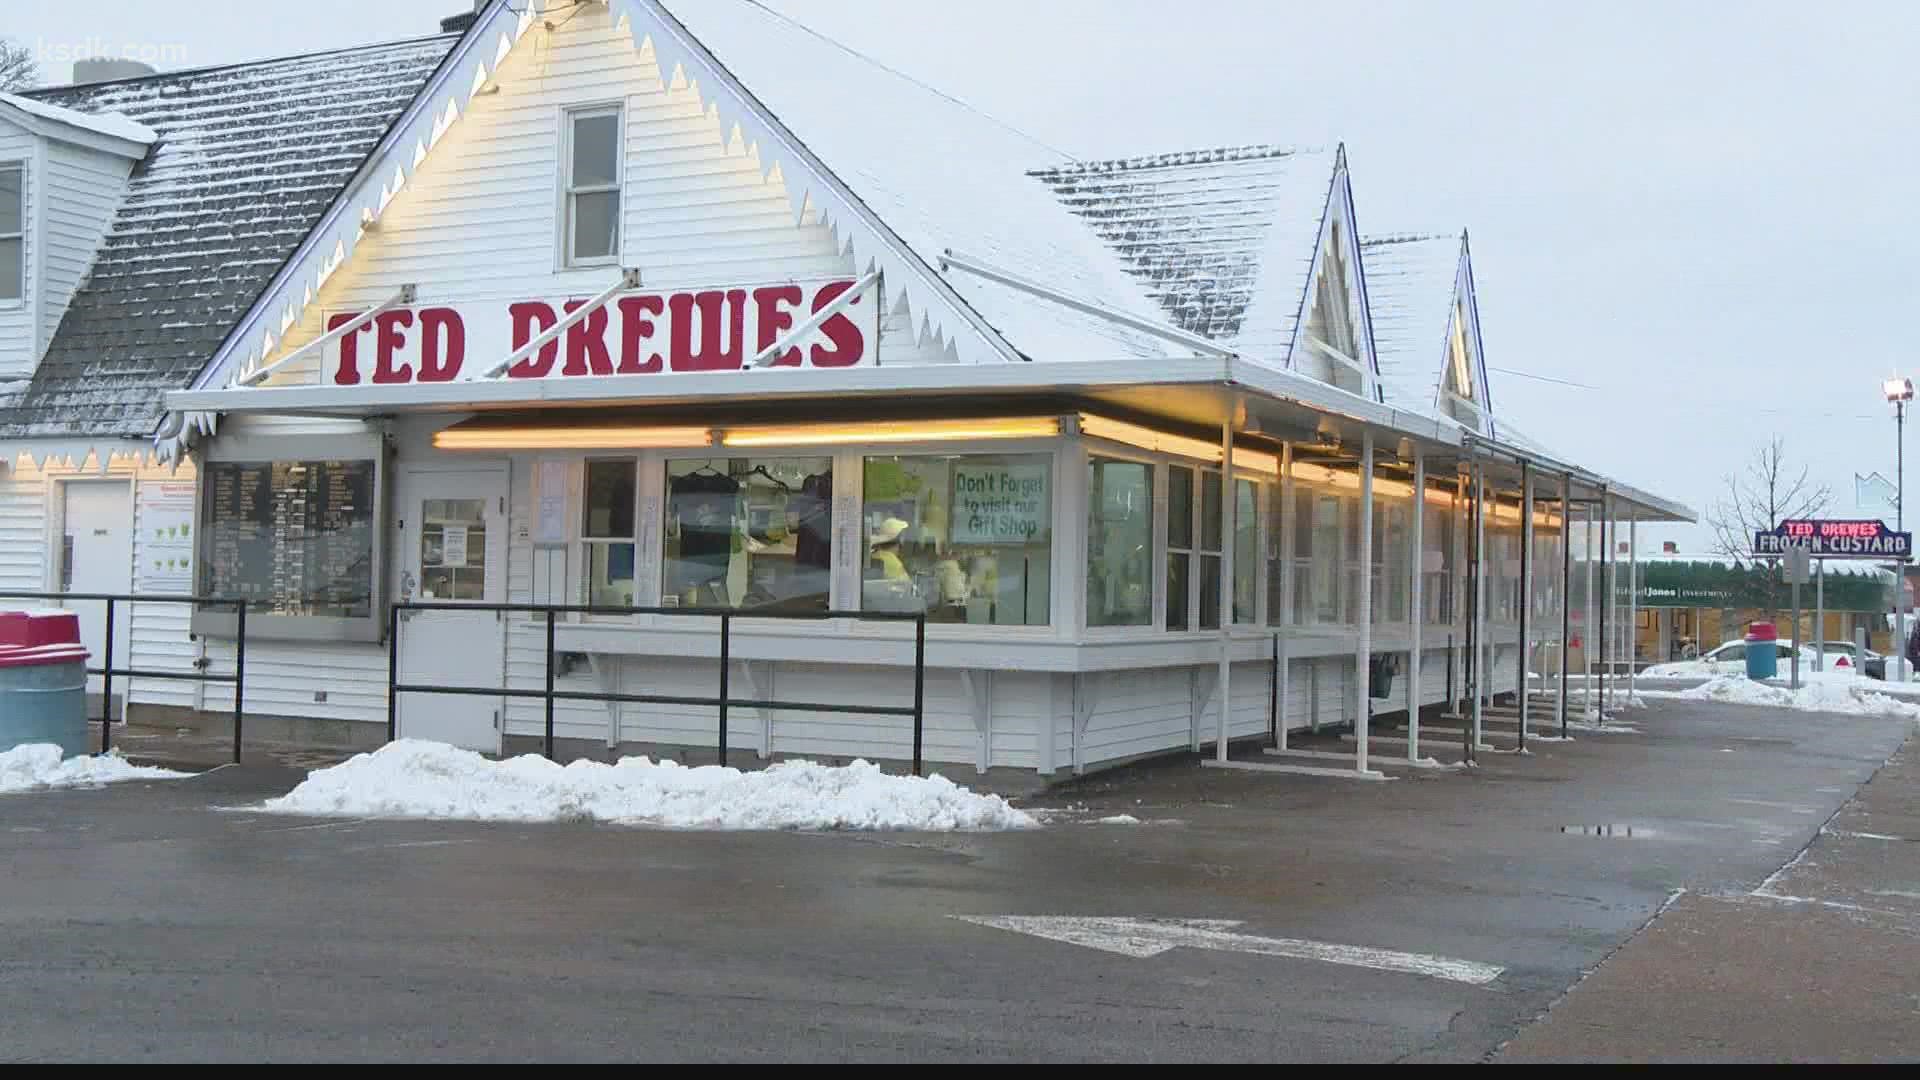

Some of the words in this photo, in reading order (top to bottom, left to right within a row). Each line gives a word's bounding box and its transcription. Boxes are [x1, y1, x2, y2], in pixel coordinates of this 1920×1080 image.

[328, 307, 465, 385] TED
[508, 281, 865, 378] DREWES
[956, 472, 994, 492] Don't
[1000, 516, 1037, 538] Shop
[1786, 522, 1814, 535] TED
[1648, 587, 1676, 597] Jones
